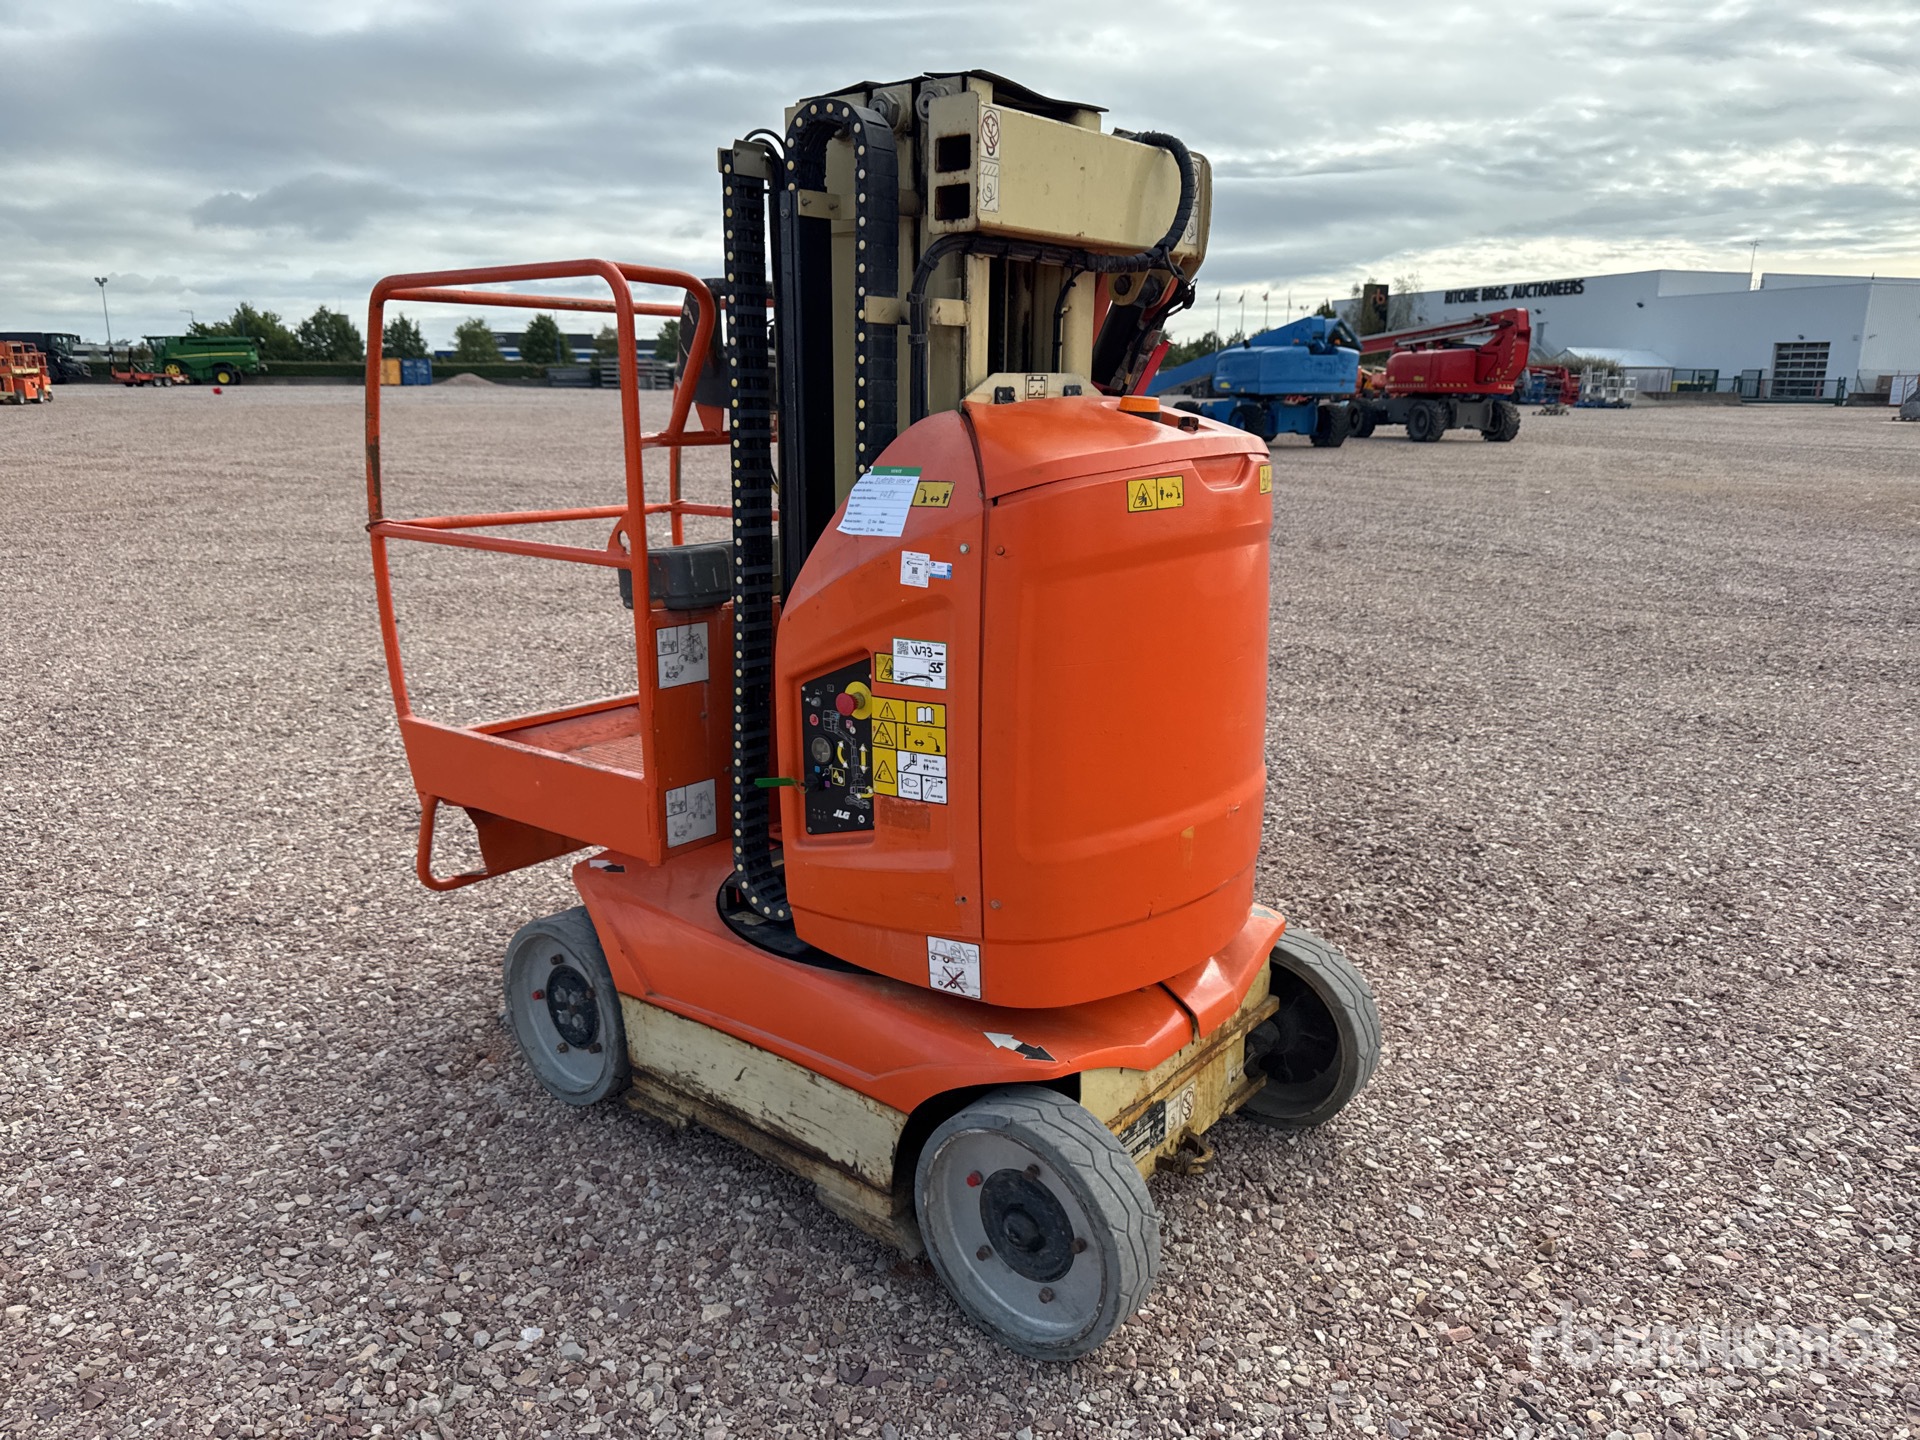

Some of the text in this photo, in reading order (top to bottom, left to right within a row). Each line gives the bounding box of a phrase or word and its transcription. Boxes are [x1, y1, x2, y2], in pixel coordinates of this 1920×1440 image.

[1444, 280, 1584, 304] RITCHIE BROS. AUCTIONEERS
[833, 809, 851, 820] JLG
